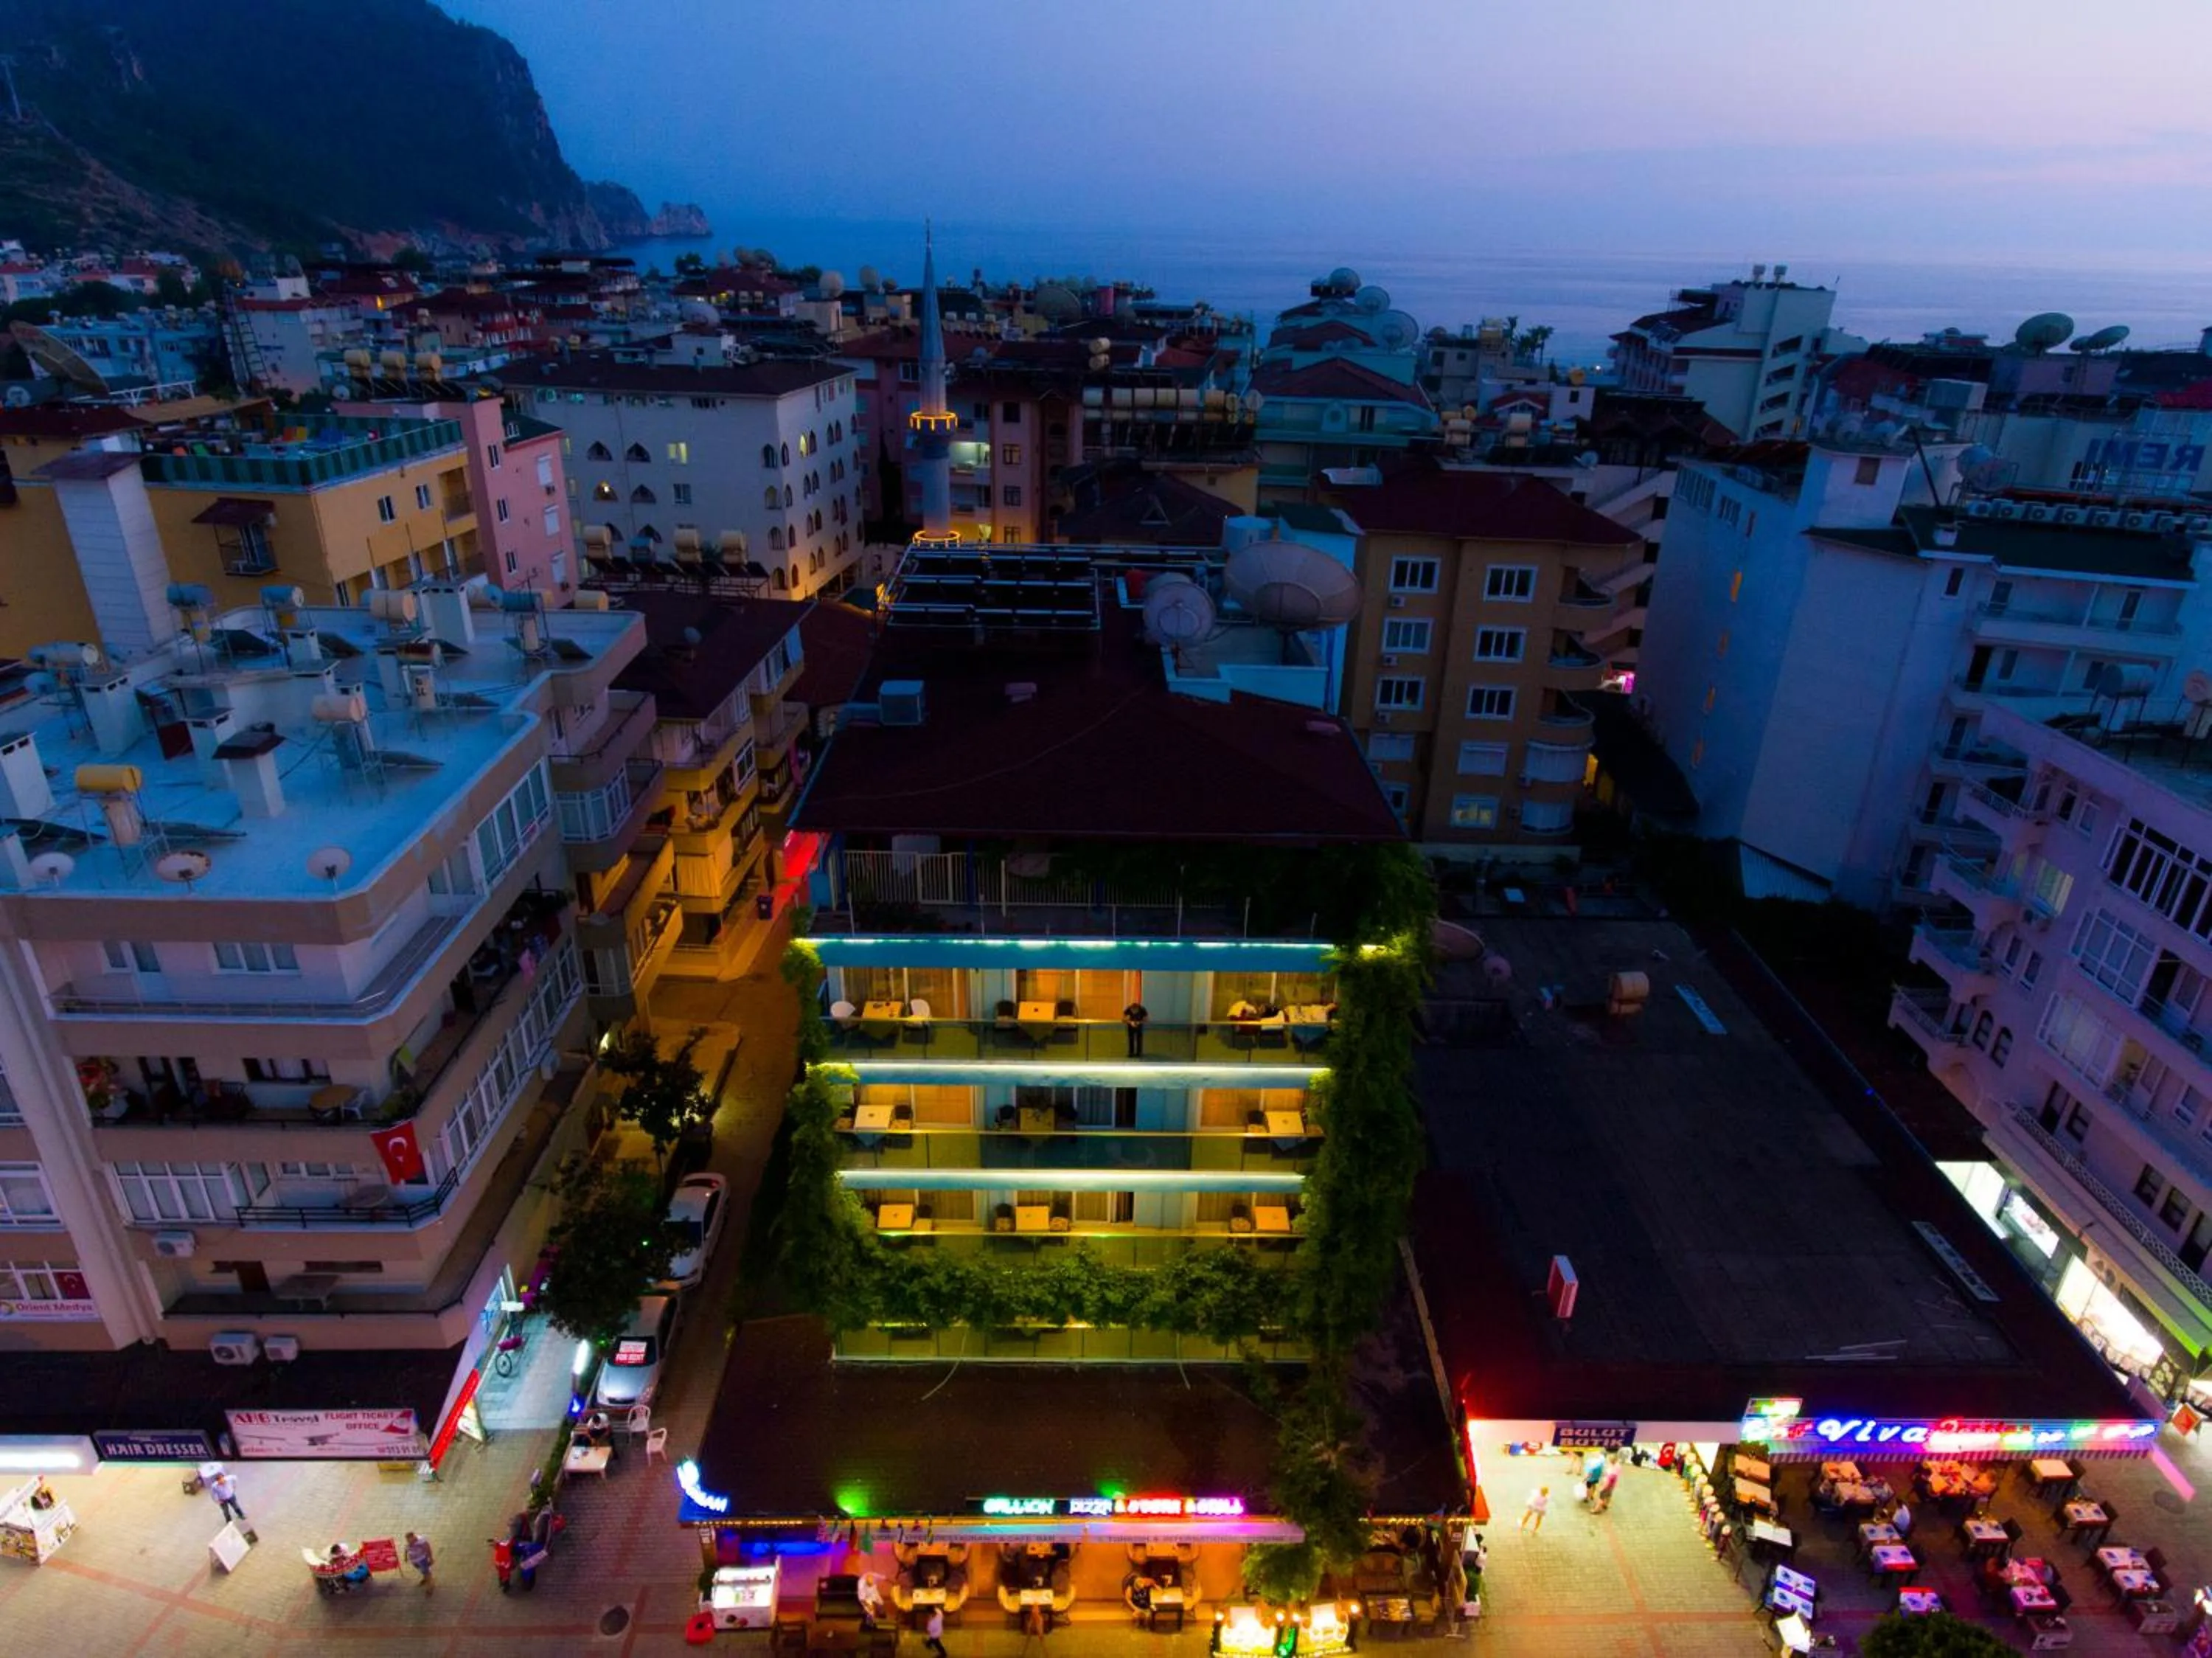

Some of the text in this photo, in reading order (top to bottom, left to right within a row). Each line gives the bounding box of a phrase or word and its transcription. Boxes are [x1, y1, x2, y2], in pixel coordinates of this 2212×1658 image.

[324, 1412, 394, 1420] FLIGHT TICKET
[345, 1422, 380, 1430] OFFICE
[1816, 1418, 1930, 1443] Viva
[1559, 1427, 1632, 1437] BULUT
[105, 1443, 208, 1456] HAIR DRESSER
